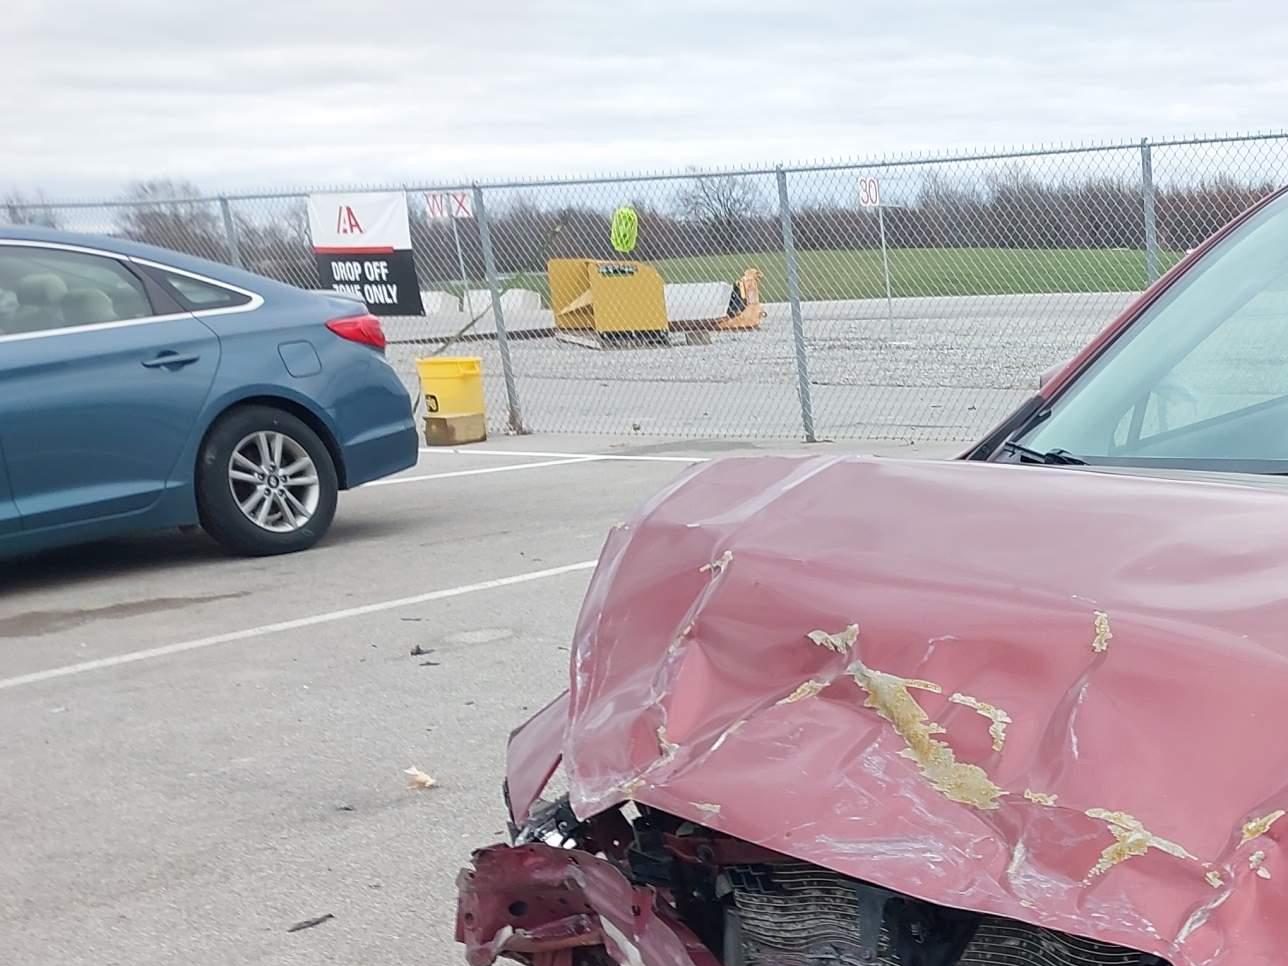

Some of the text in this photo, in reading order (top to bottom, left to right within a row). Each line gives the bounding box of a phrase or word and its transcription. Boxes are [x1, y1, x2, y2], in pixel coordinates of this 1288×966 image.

[331, 261, 389, 282] DROP OFF
[364, 284, 398, 304] ONLY
